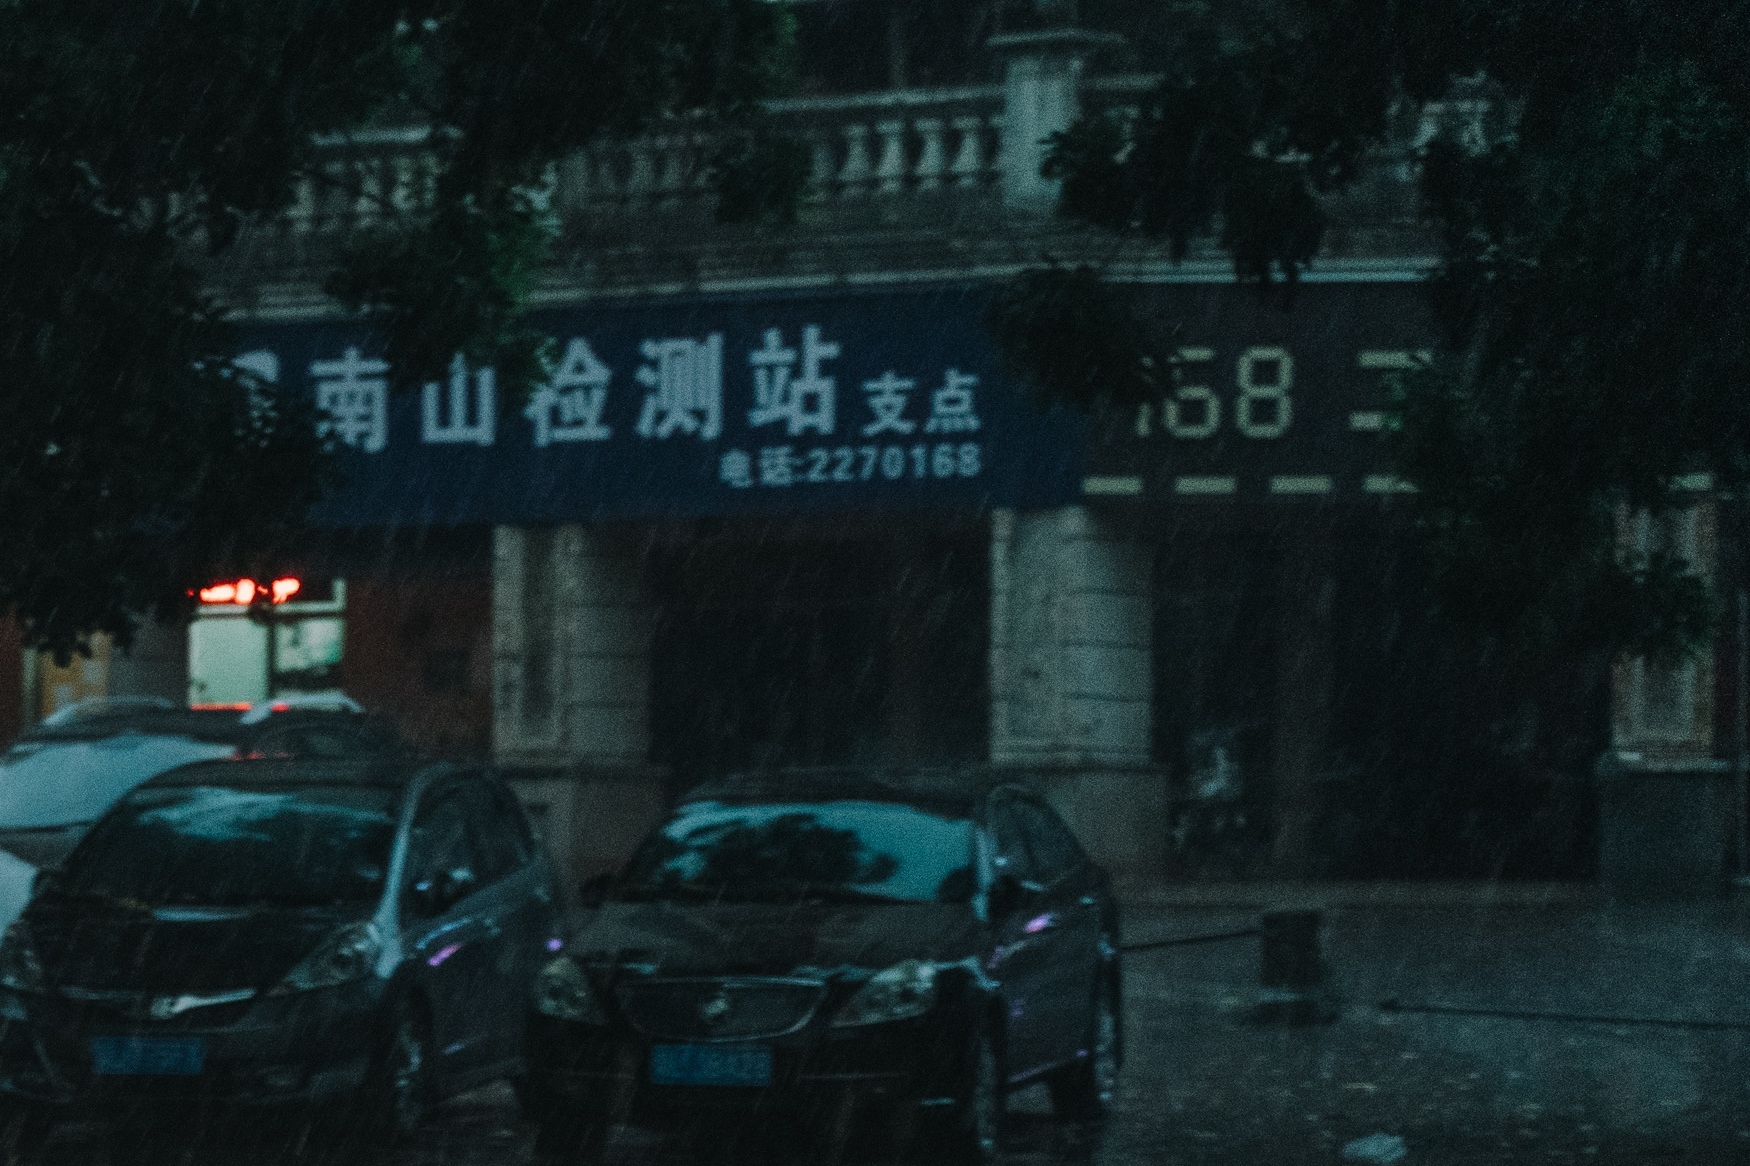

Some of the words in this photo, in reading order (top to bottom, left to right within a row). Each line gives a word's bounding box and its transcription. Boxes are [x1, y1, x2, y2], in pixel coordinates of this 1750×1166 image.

[309, 325, 842, 454] 南山检测站
[862, 367, 983, 438] 支点
